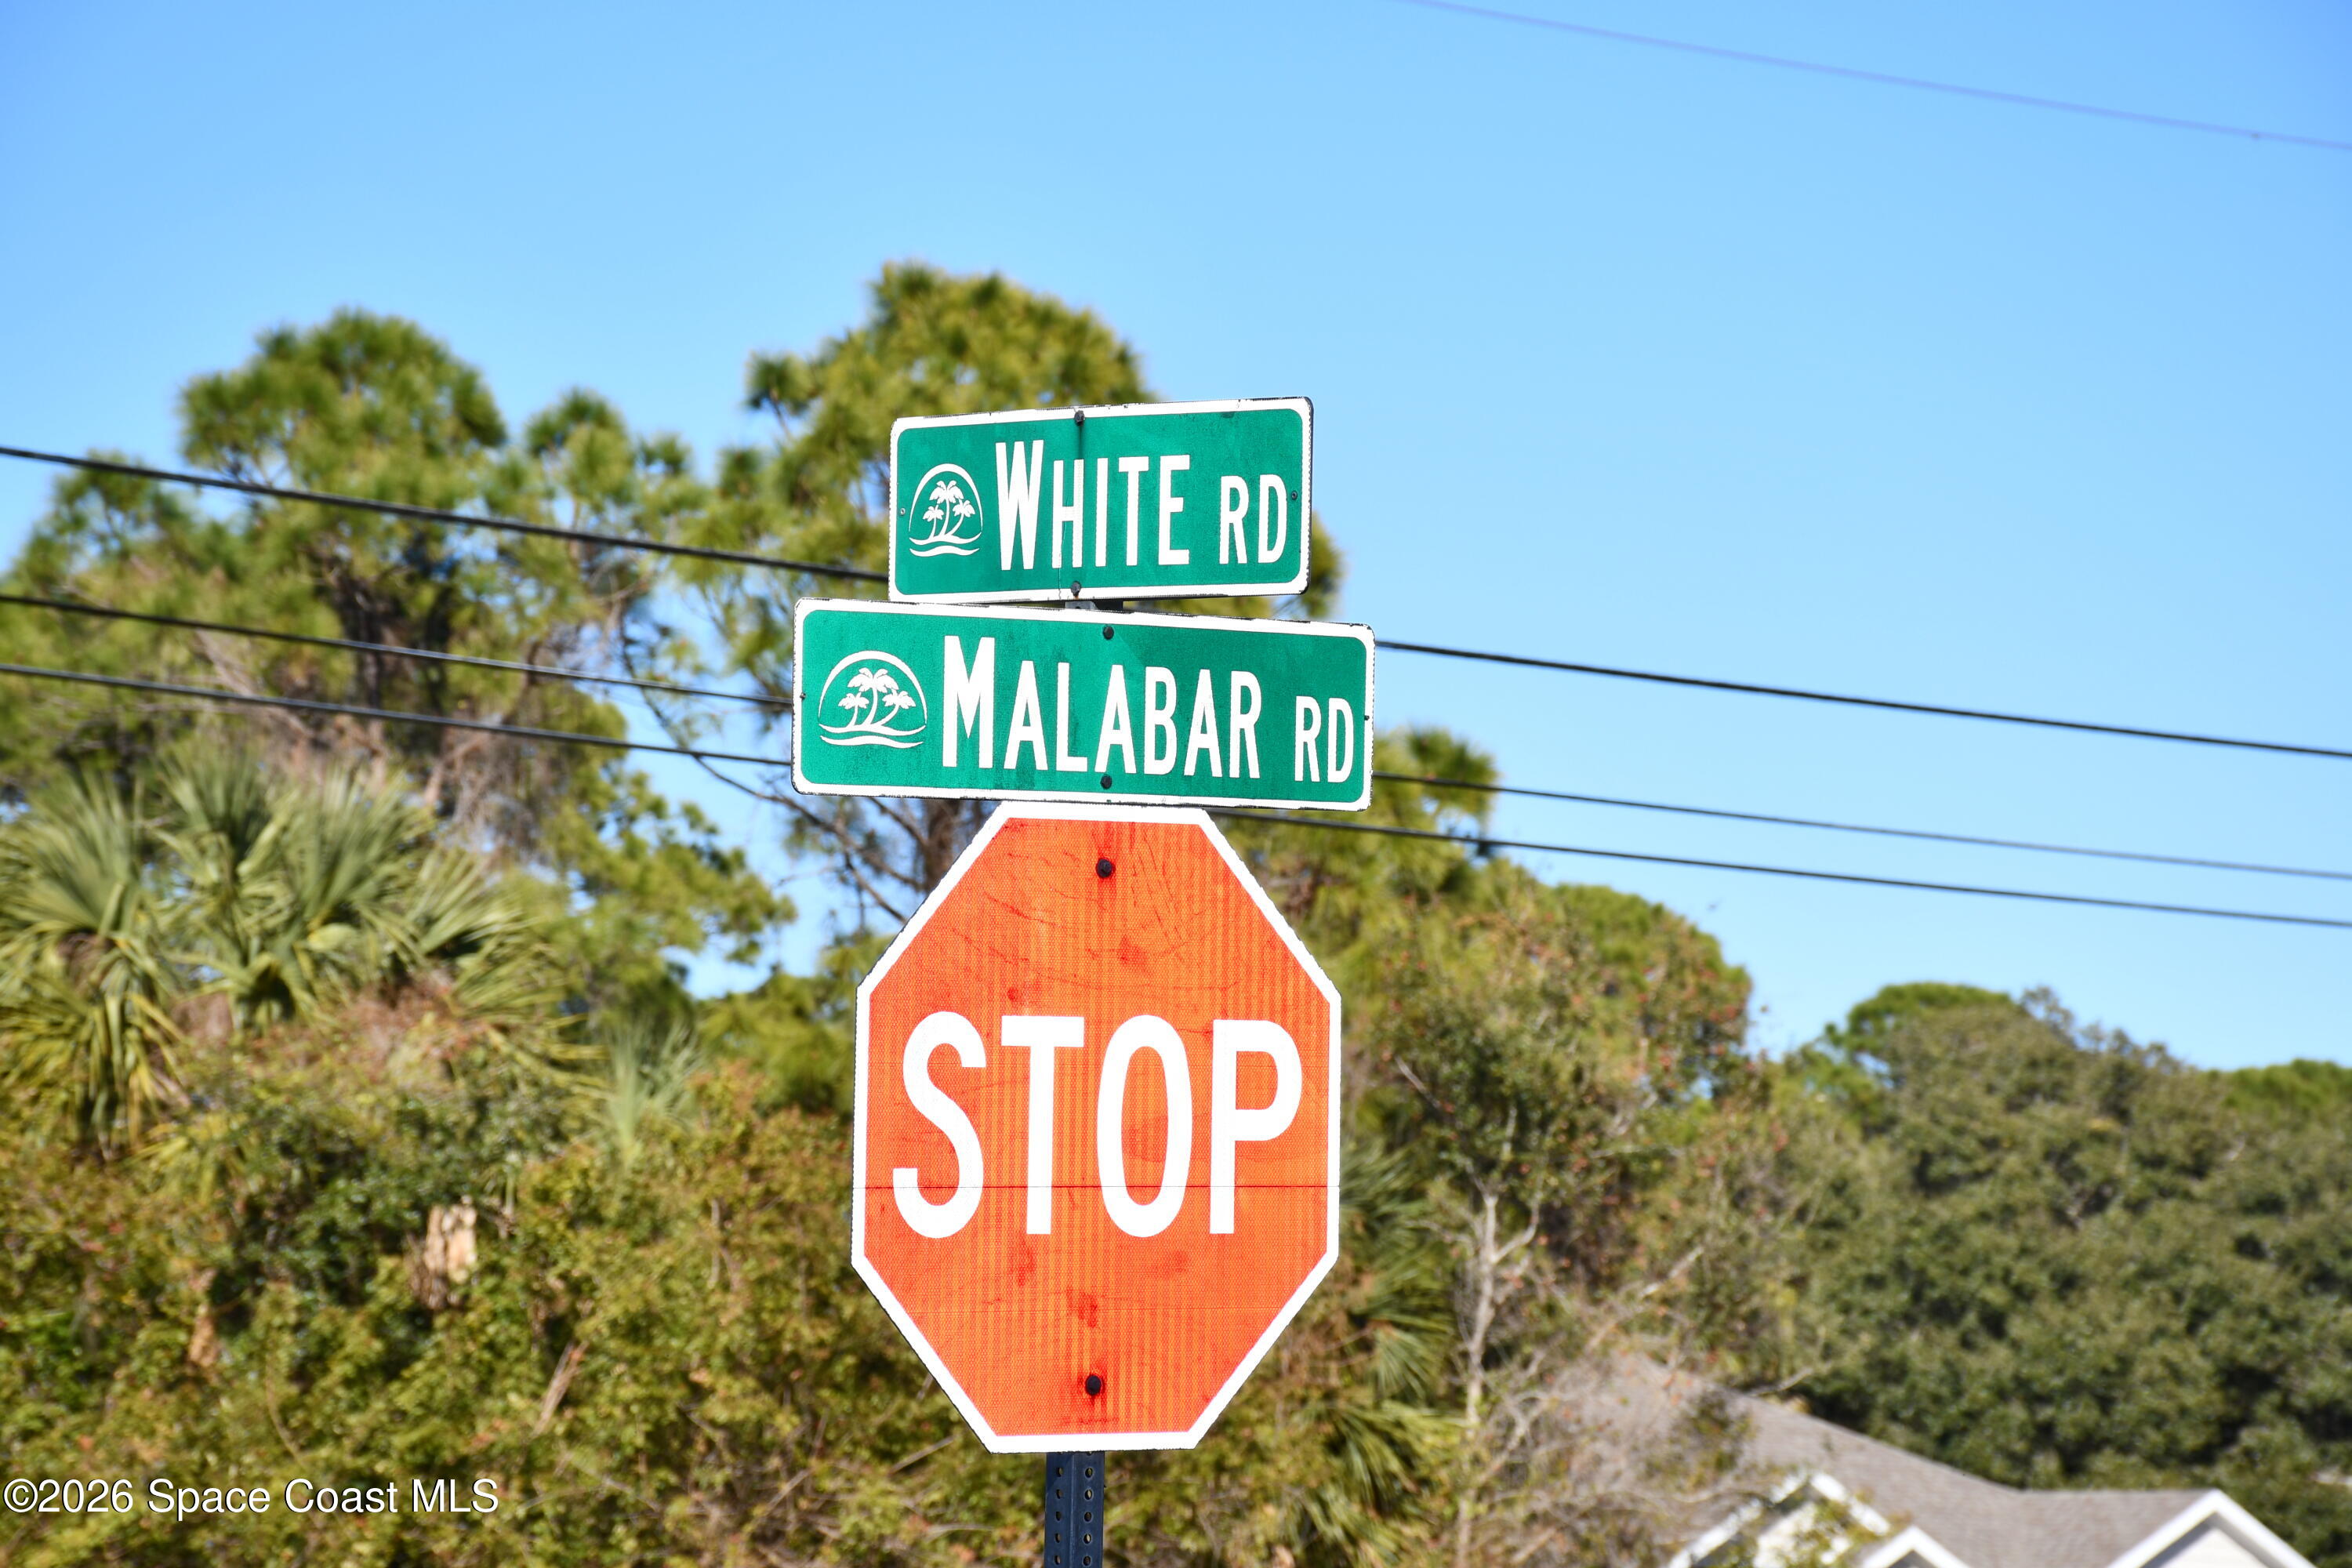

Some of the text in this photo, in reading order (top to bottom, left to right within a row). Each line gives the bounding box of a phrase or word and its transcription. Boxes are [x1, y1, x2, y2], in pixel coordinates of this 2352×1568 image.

[1219, 474, 1288, 565] RD
[1294, 695, 1355, 783] RD
[892, 1011, 1303, 1239] STOP
